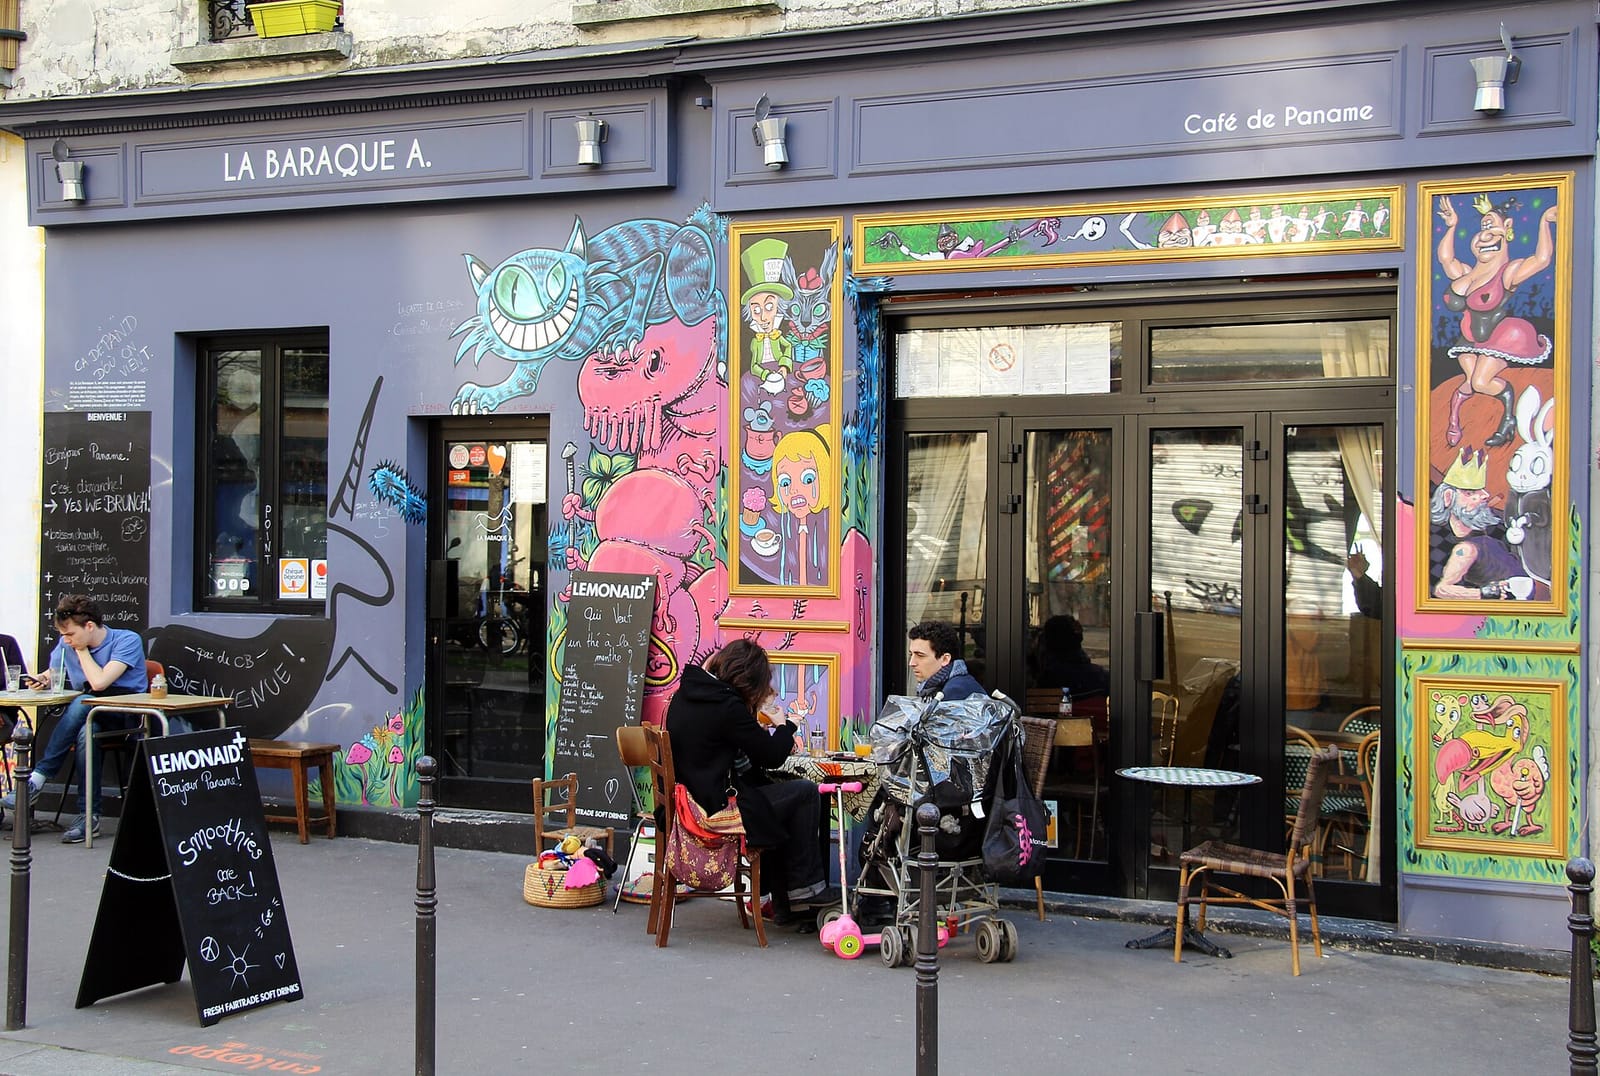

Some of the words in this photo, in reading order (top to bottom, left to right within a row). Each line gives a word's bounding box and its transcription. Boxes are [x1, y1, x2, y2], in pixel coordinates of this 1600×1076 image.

[1184, 112, 1238, 134] Café
[1246, 109, 1275, 130] de
[1284, 105, 1374, 126] Paname
[224, 152, 255, 182] LA
[266, 140, 396, 177] BARAQUE
[87, 413, 122, 421] BIENVENUE
[45, 447, 84, 470] Bonjour
[64, 498, 82, 513] YES
[86, 498, 102, 512] WE
[234, 654, 255, 669] CB
[158, 777, 199, 806] Bonjour
[595, 810, 609, 818] SOFT
[178, 818, 263, 866] Smoothies
[216, 868, 238, 882] are
[203, 1002, 224, 1018] FRESH
[224, 994, 260, 1012] FAIRTRADE
[260, 990, 276, 1002] SOFT
[276, 983, 300, 998] DRINKS
